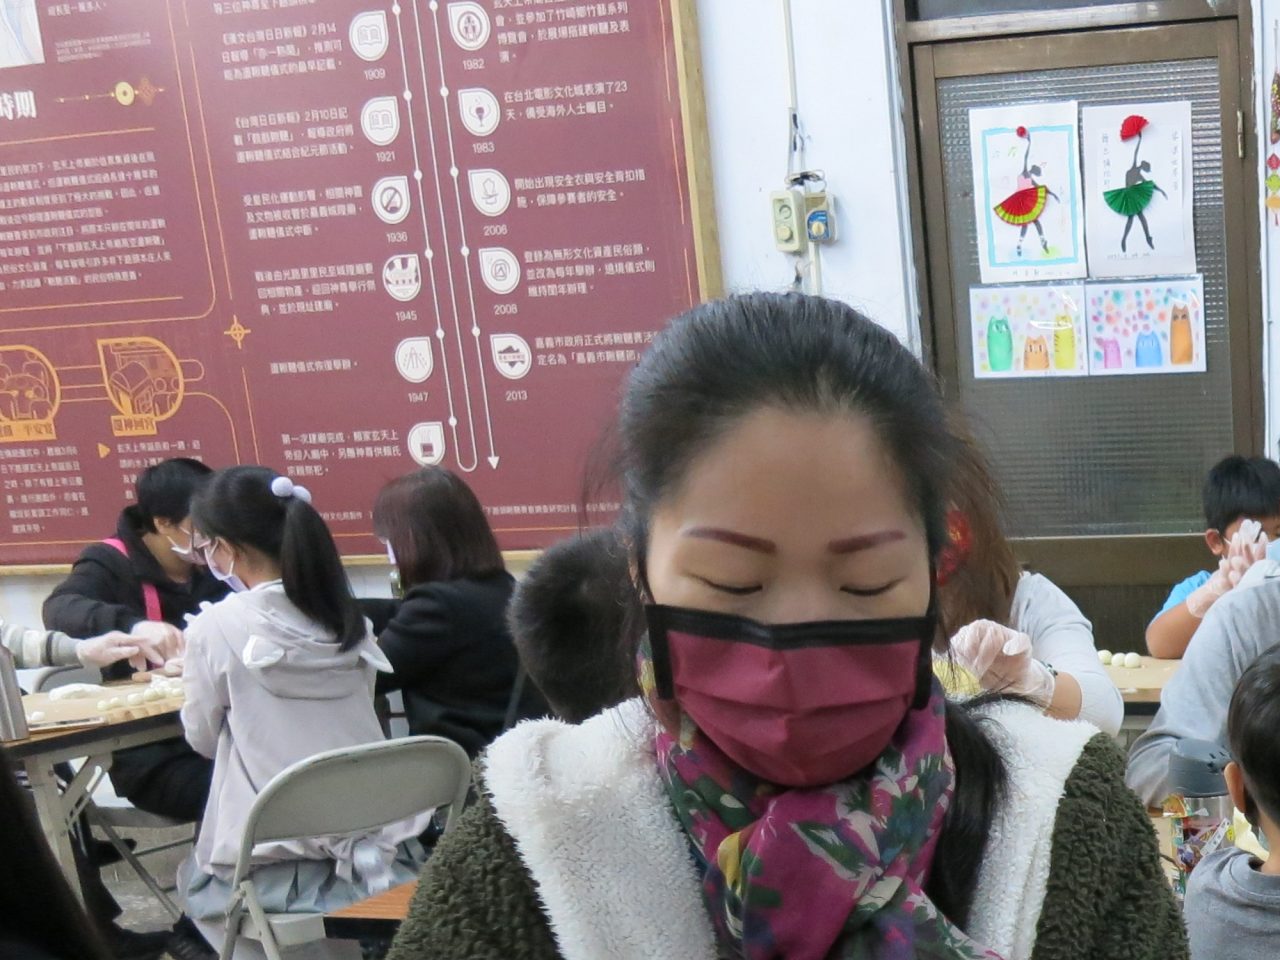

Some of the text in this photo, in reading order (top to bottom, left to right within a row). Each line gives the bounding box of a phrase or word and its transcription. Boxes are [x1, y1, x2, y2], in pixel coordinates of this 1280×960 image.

[463, 59, 485, 71] 1982
[364, 69, 386, 80] 1909
[472, 142, 495, 154] 1983
[376, 151, 396, 162] 1921
[396, 310, 418, 321] 1945
[494, 304, 518, 316] 2008
[408, 392, 429, 403] 1947
[506, 391, 528, 401] 2013
